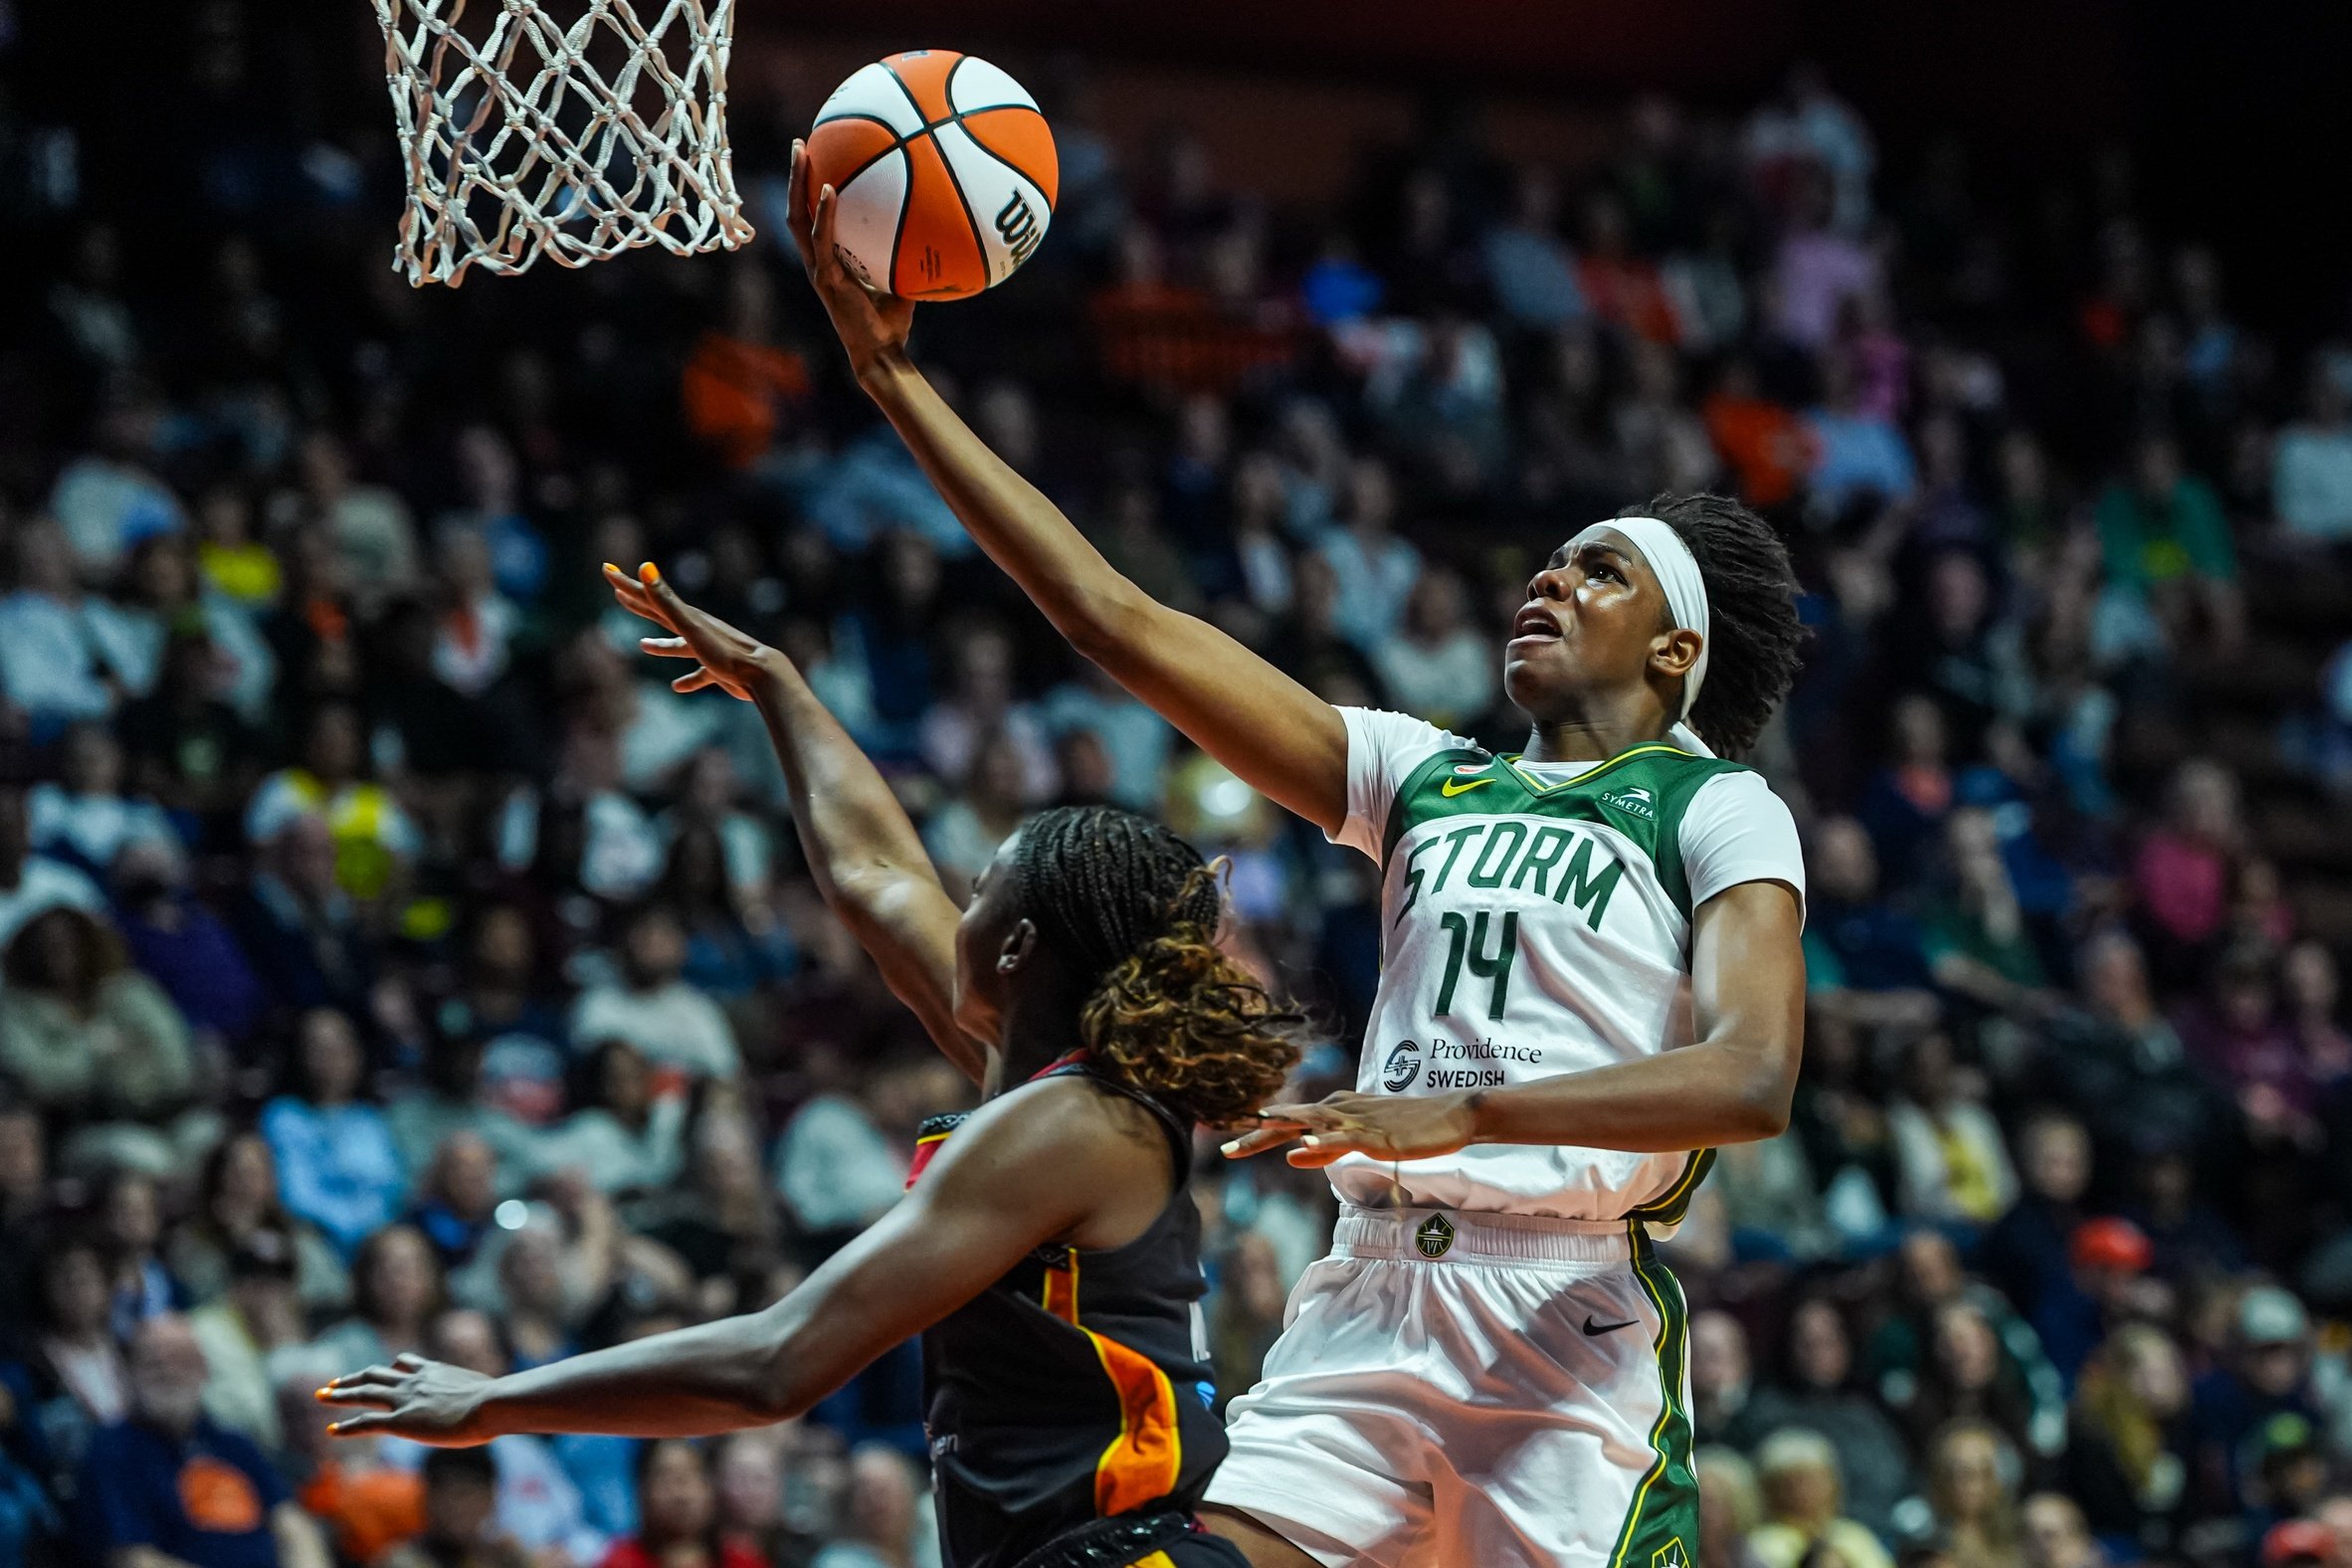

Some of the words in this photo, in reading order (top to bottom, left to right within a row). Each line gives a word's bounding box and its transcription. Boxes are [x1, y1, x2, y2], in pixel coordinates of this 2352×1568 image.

[1602, 792, 1654, 818] SYMETRA
[1394, 821, 1626, 933] STORM
[1434, 910, 1519, 1021] 14
[1430, 1037, 1542, 1064] Providence
[1427, 1070, 1505, 1088] SWEDISH
